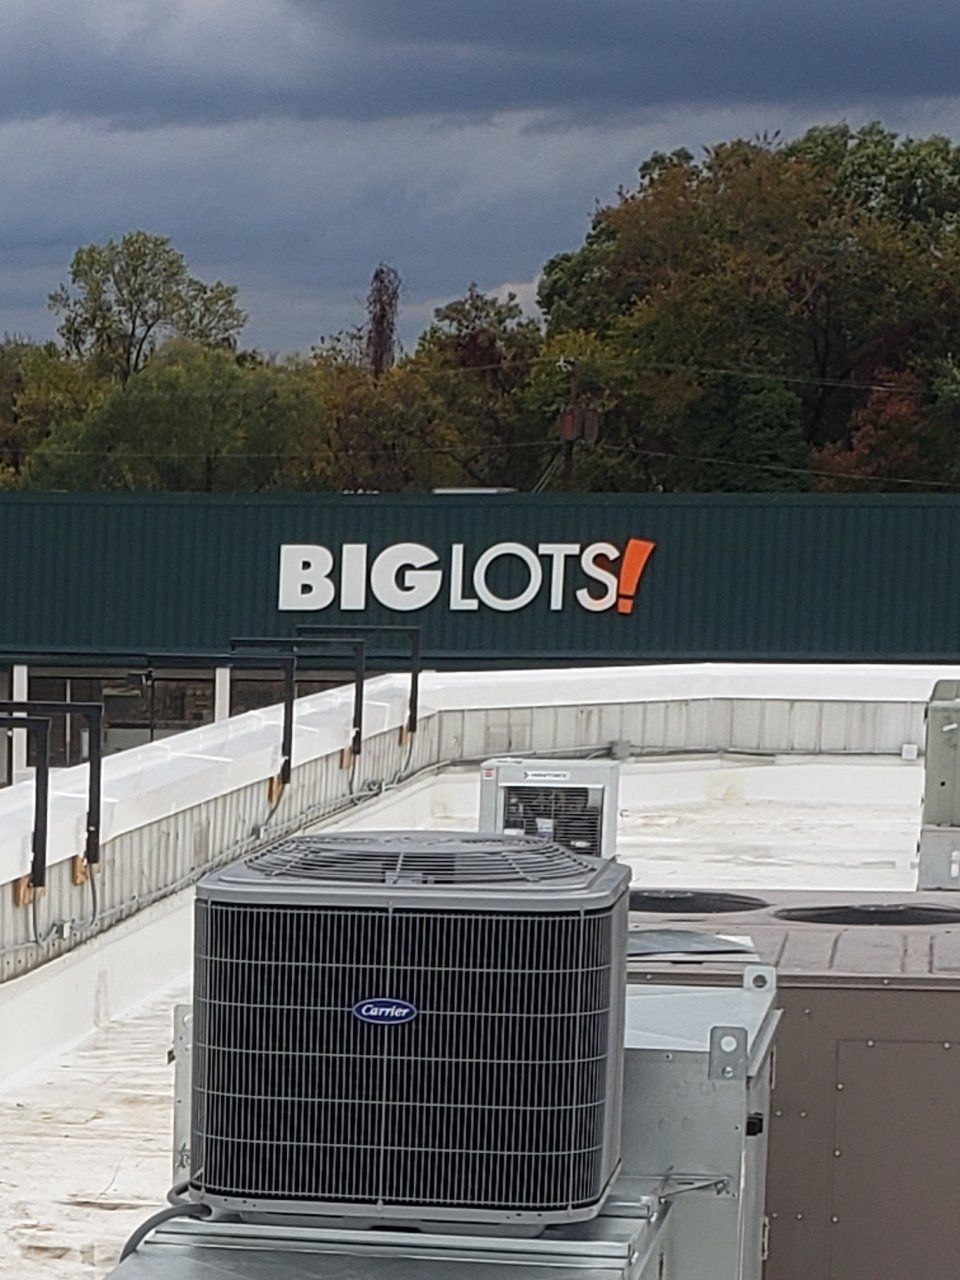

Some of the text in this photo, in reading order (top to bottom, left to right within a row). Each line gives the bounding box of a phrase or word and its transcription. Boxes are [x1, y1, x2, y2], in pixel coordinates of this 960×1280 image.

[278, 538, 656, 614] BIG LOTS!
[361, 1004, 410, 1017] Carrier
